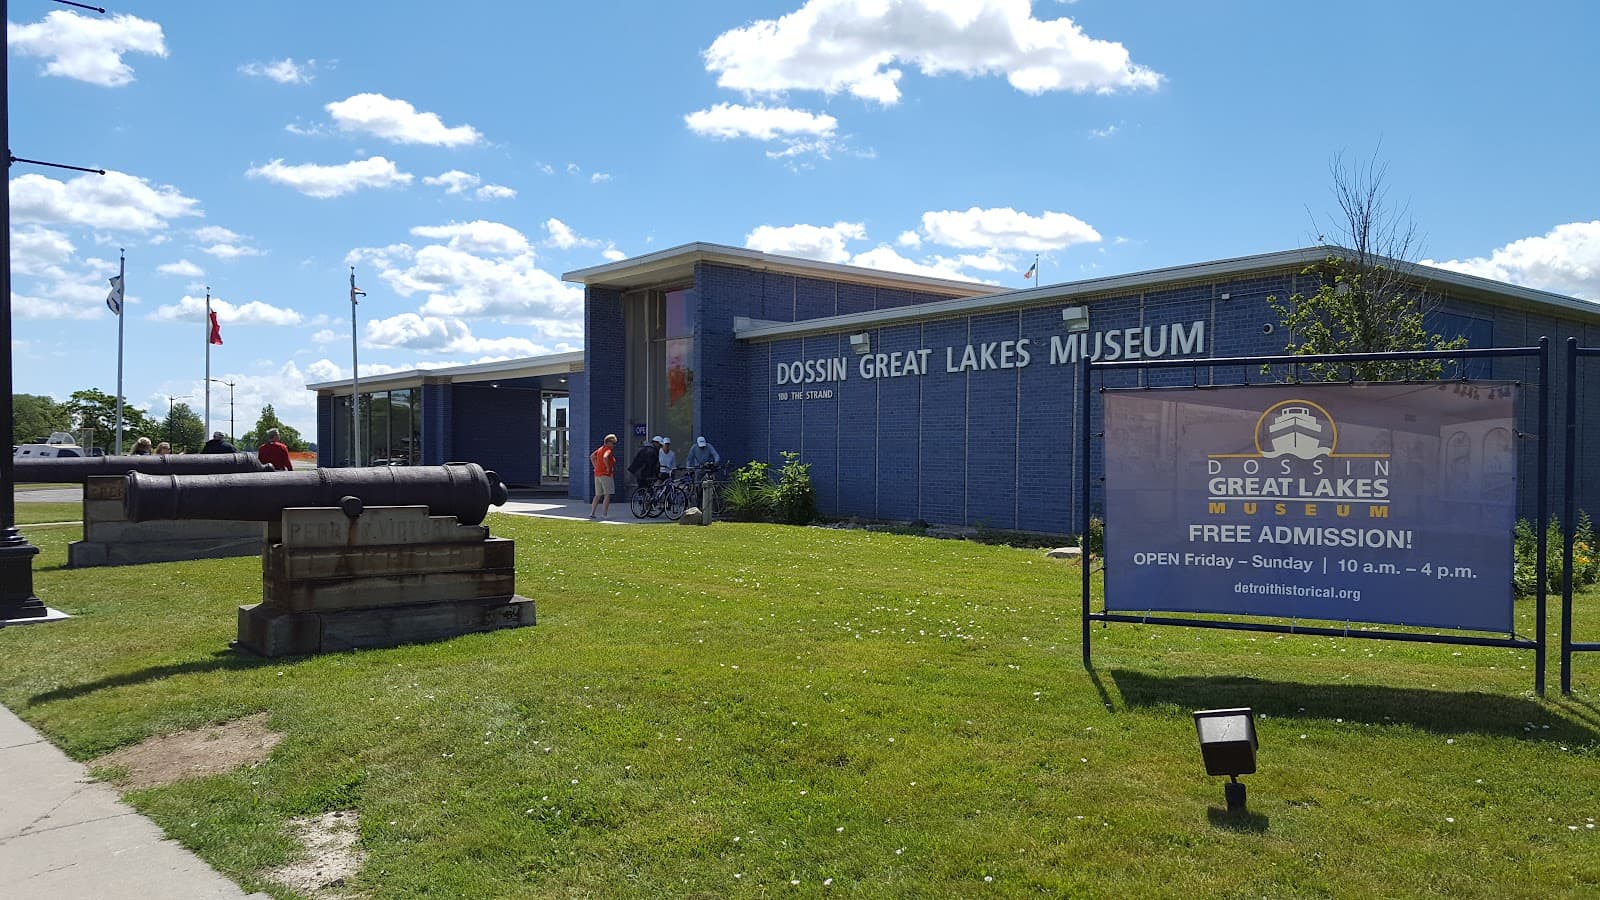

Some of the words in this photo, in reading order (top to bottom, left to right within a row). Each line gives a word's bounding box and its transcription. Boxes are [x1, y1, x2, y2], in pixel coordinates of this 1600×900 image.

[777, 357, 847, 385] DOSSIN
[859, 348, 932, 379] GREAT
[946, 338, 1031, 373] LAKES
[1050, 320, 1205, 364] MUSEUM
[778, 392, 788, 401] 100
[791, 391, 803, 400] THE
[806, 389, 833, 400] STRAND
[1208, 459, 1389, 476] DOSSIN
[1208, 477, 1293, 496] GREAT
[1299, 478, 1389, 498] LAKES
[1208, 502, 1389, 518] MUSEUM
[1189, 524, 1251, 543] FREE
[1258, 525, 1412, 549] ADMISSION!
[1133, 552, 1180, 566] OPEN
[1184, 552, 1234, 569] Friday
[1252, 555, 1313, 573] Sunday
[1338, 559, 1358, 573] 10
[1363, 562, 1400, 575] a.m.
[1421, 562, 1432, 576] 4
[1437, 566, 1477, 579] p.m.
[1234, 581, 1361, 601] detroithistorical.org
